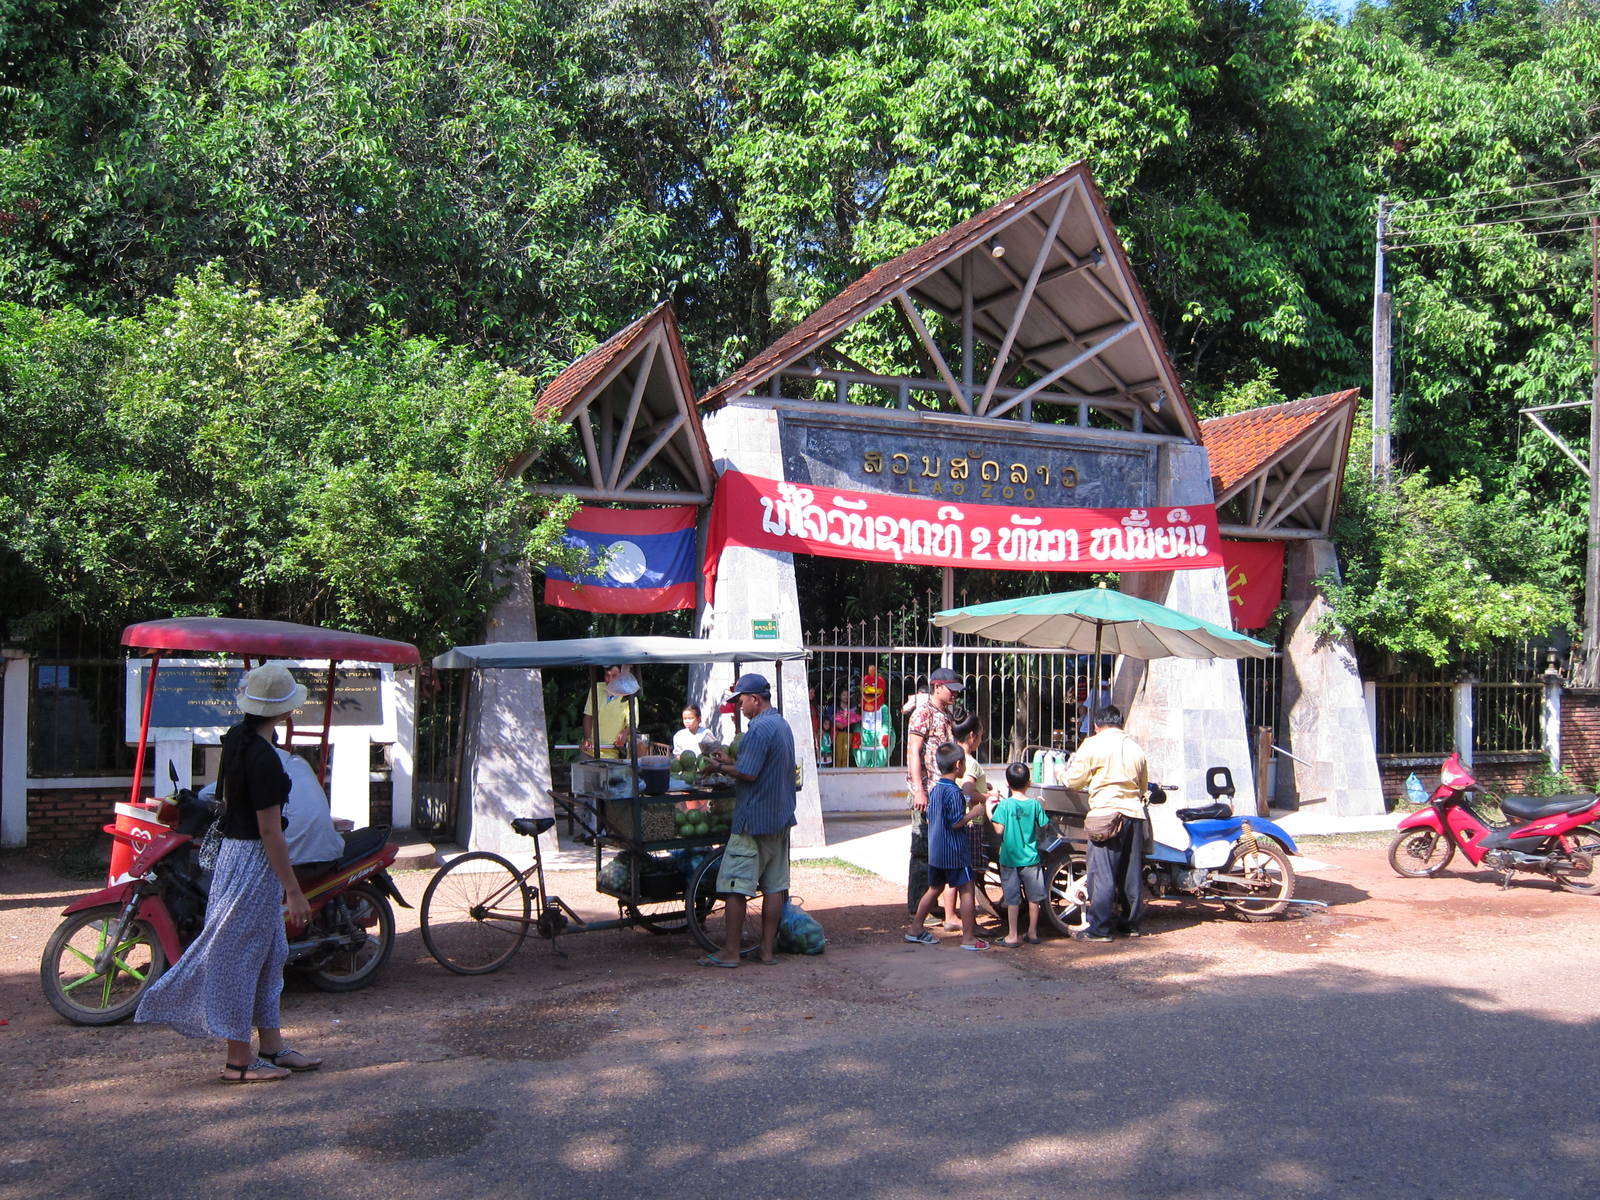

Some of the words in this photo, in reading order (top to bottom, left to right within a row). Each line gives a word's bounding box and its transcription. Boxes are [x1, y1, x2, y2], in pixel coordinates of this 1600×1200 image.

[864, 450, 1079, 488] ສວນສັດລາວ
[908, 478, 965, 495] LAO
[981, 484, 1036, 501] ZOO
[970, 526, 992, 562] 2
[998, 513, 1079, 562] ທັນວາ
